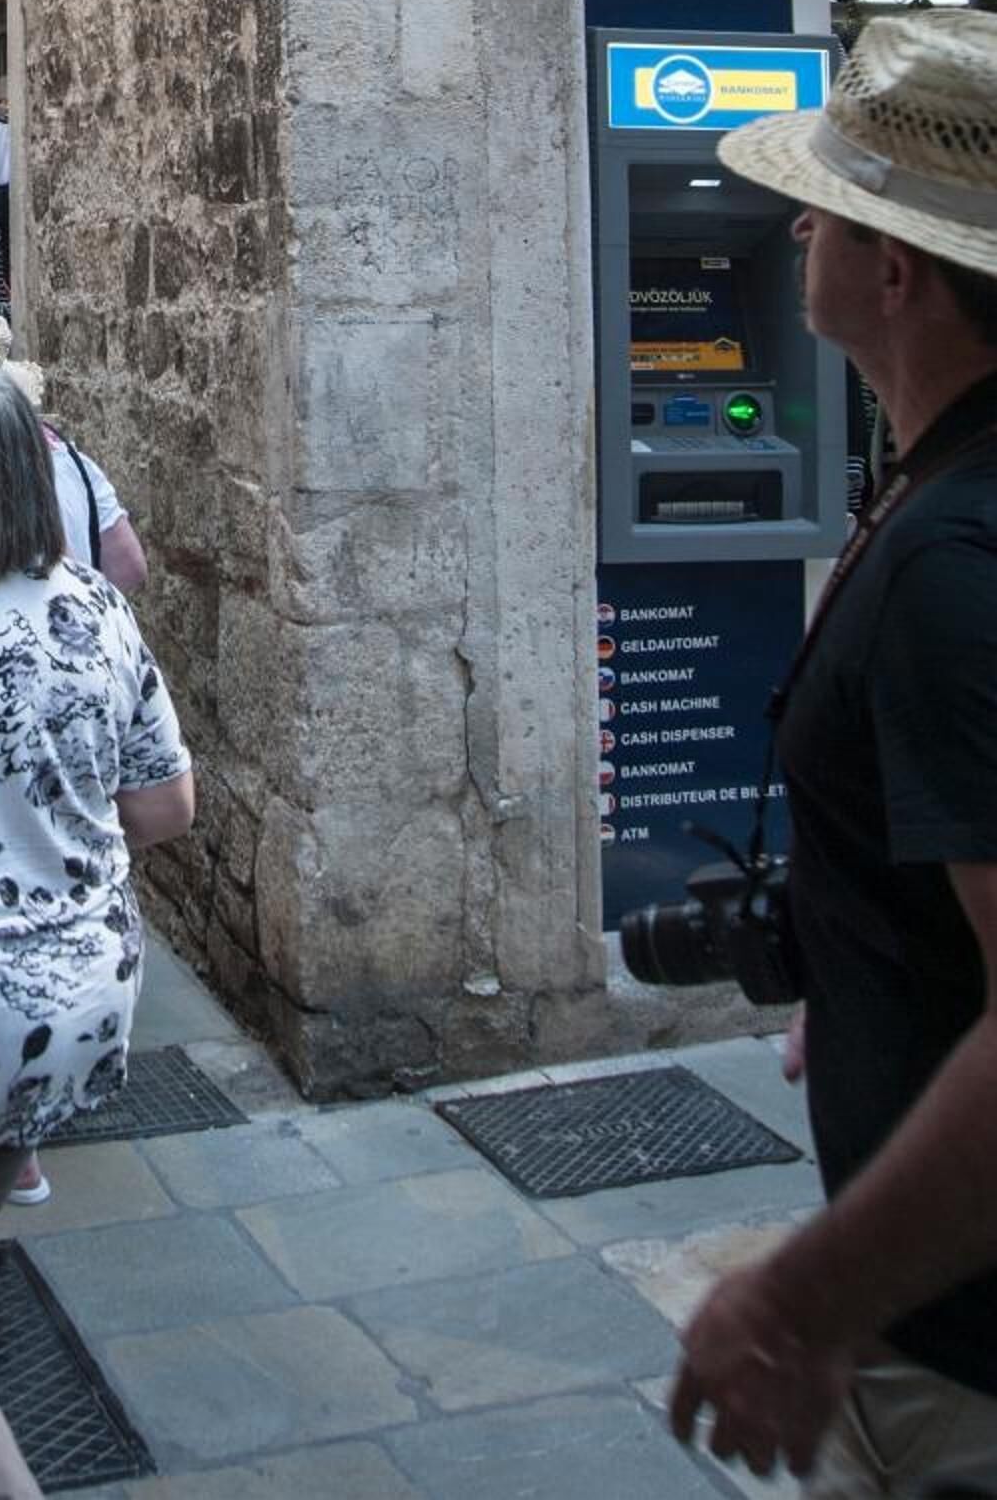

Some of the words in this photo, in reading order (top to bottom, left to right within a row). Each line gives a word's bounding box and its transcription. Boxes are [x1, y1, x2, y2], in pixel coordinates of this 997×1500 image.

[620, 606, 695, 621] BANKOMAT
[620, 636, 720, 653] GELDAUTOMAT
[620, 668, 695, 685] BANKOMAT
[620, 700, 658, 714] CASH
[660, 696, 720, 712] MACHINE
[620, 731, 658, 746] CASH
[661, 726, 735, 742] DISPENSER
[620, 761, 695, 778] BANKOMAT
[620, 789, 717, 808] DISTRIBUTEUR
[719, 787, 737, 800] DE
[740, 784, 788, 799] BILET
[620, 828, 650, 841] ATM
